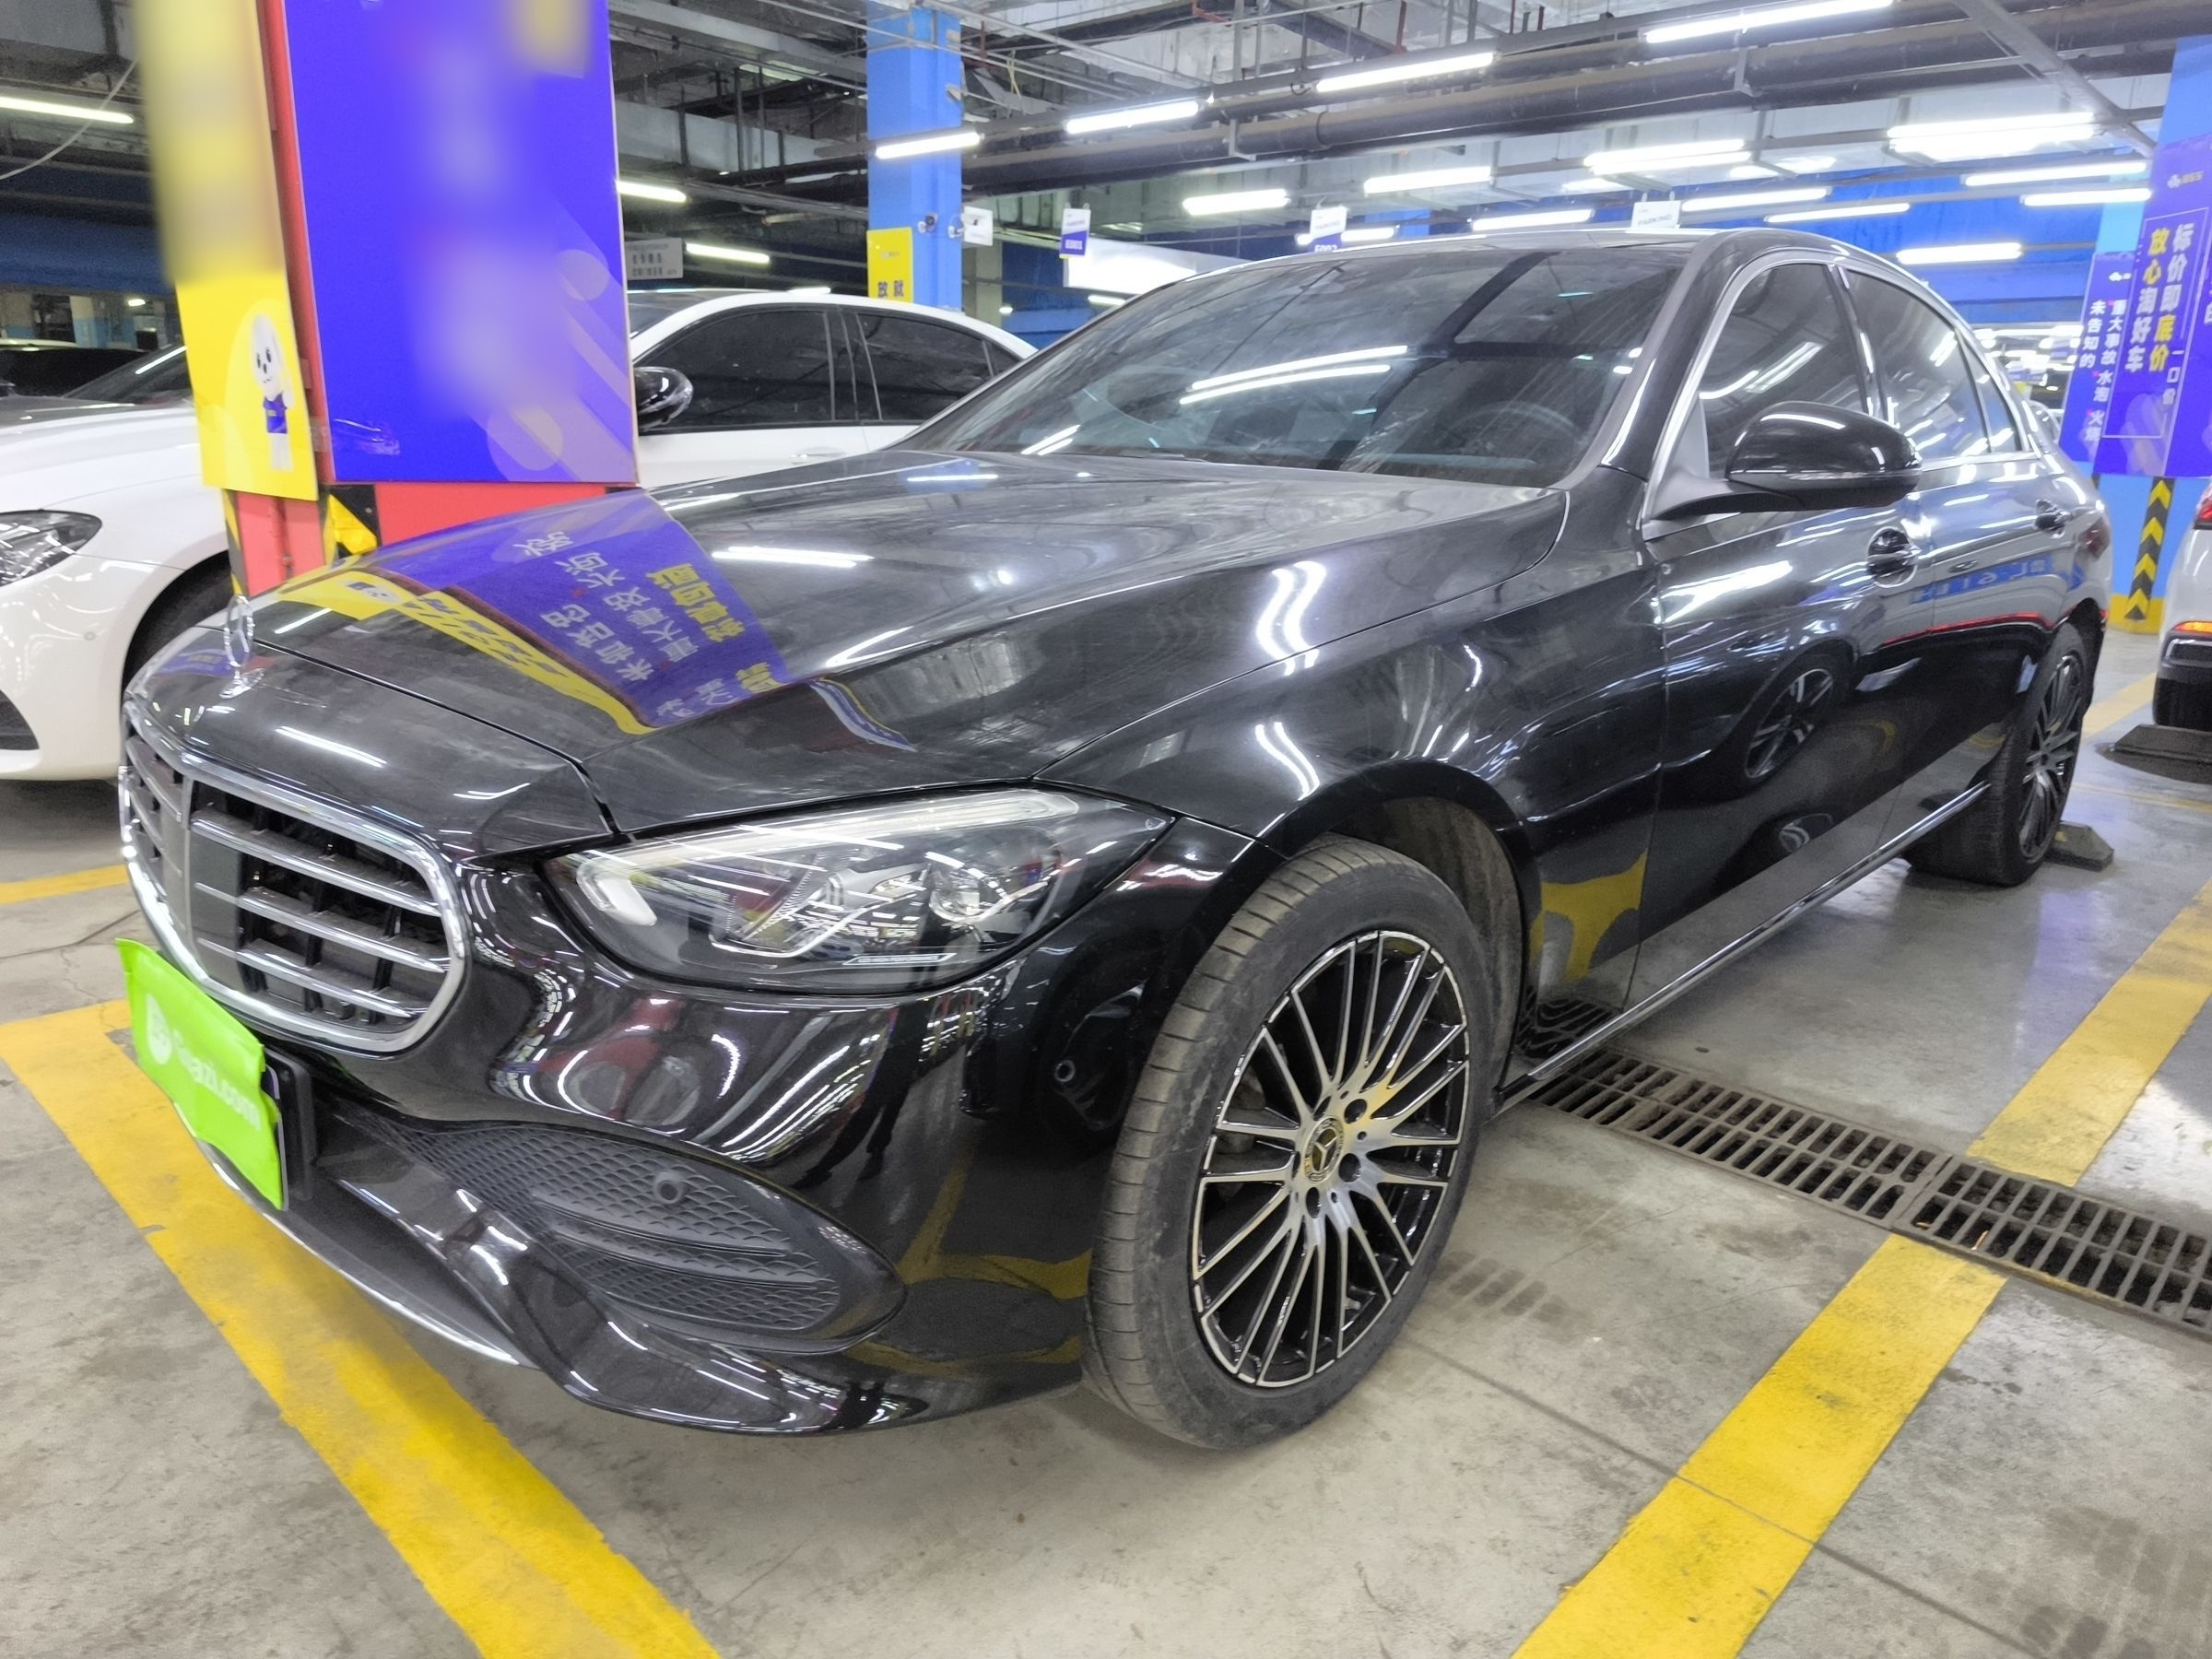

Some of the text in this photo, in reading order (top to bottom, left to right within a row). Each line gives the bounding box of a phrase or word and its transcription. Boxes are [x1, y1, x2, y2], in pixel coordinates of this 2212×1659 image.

[2078, 300, 2106, 369] 未告知的
[2124, 227, 2171, 373] 放心淘好车
[2150, 222, 2194, 373] 标价即底价
